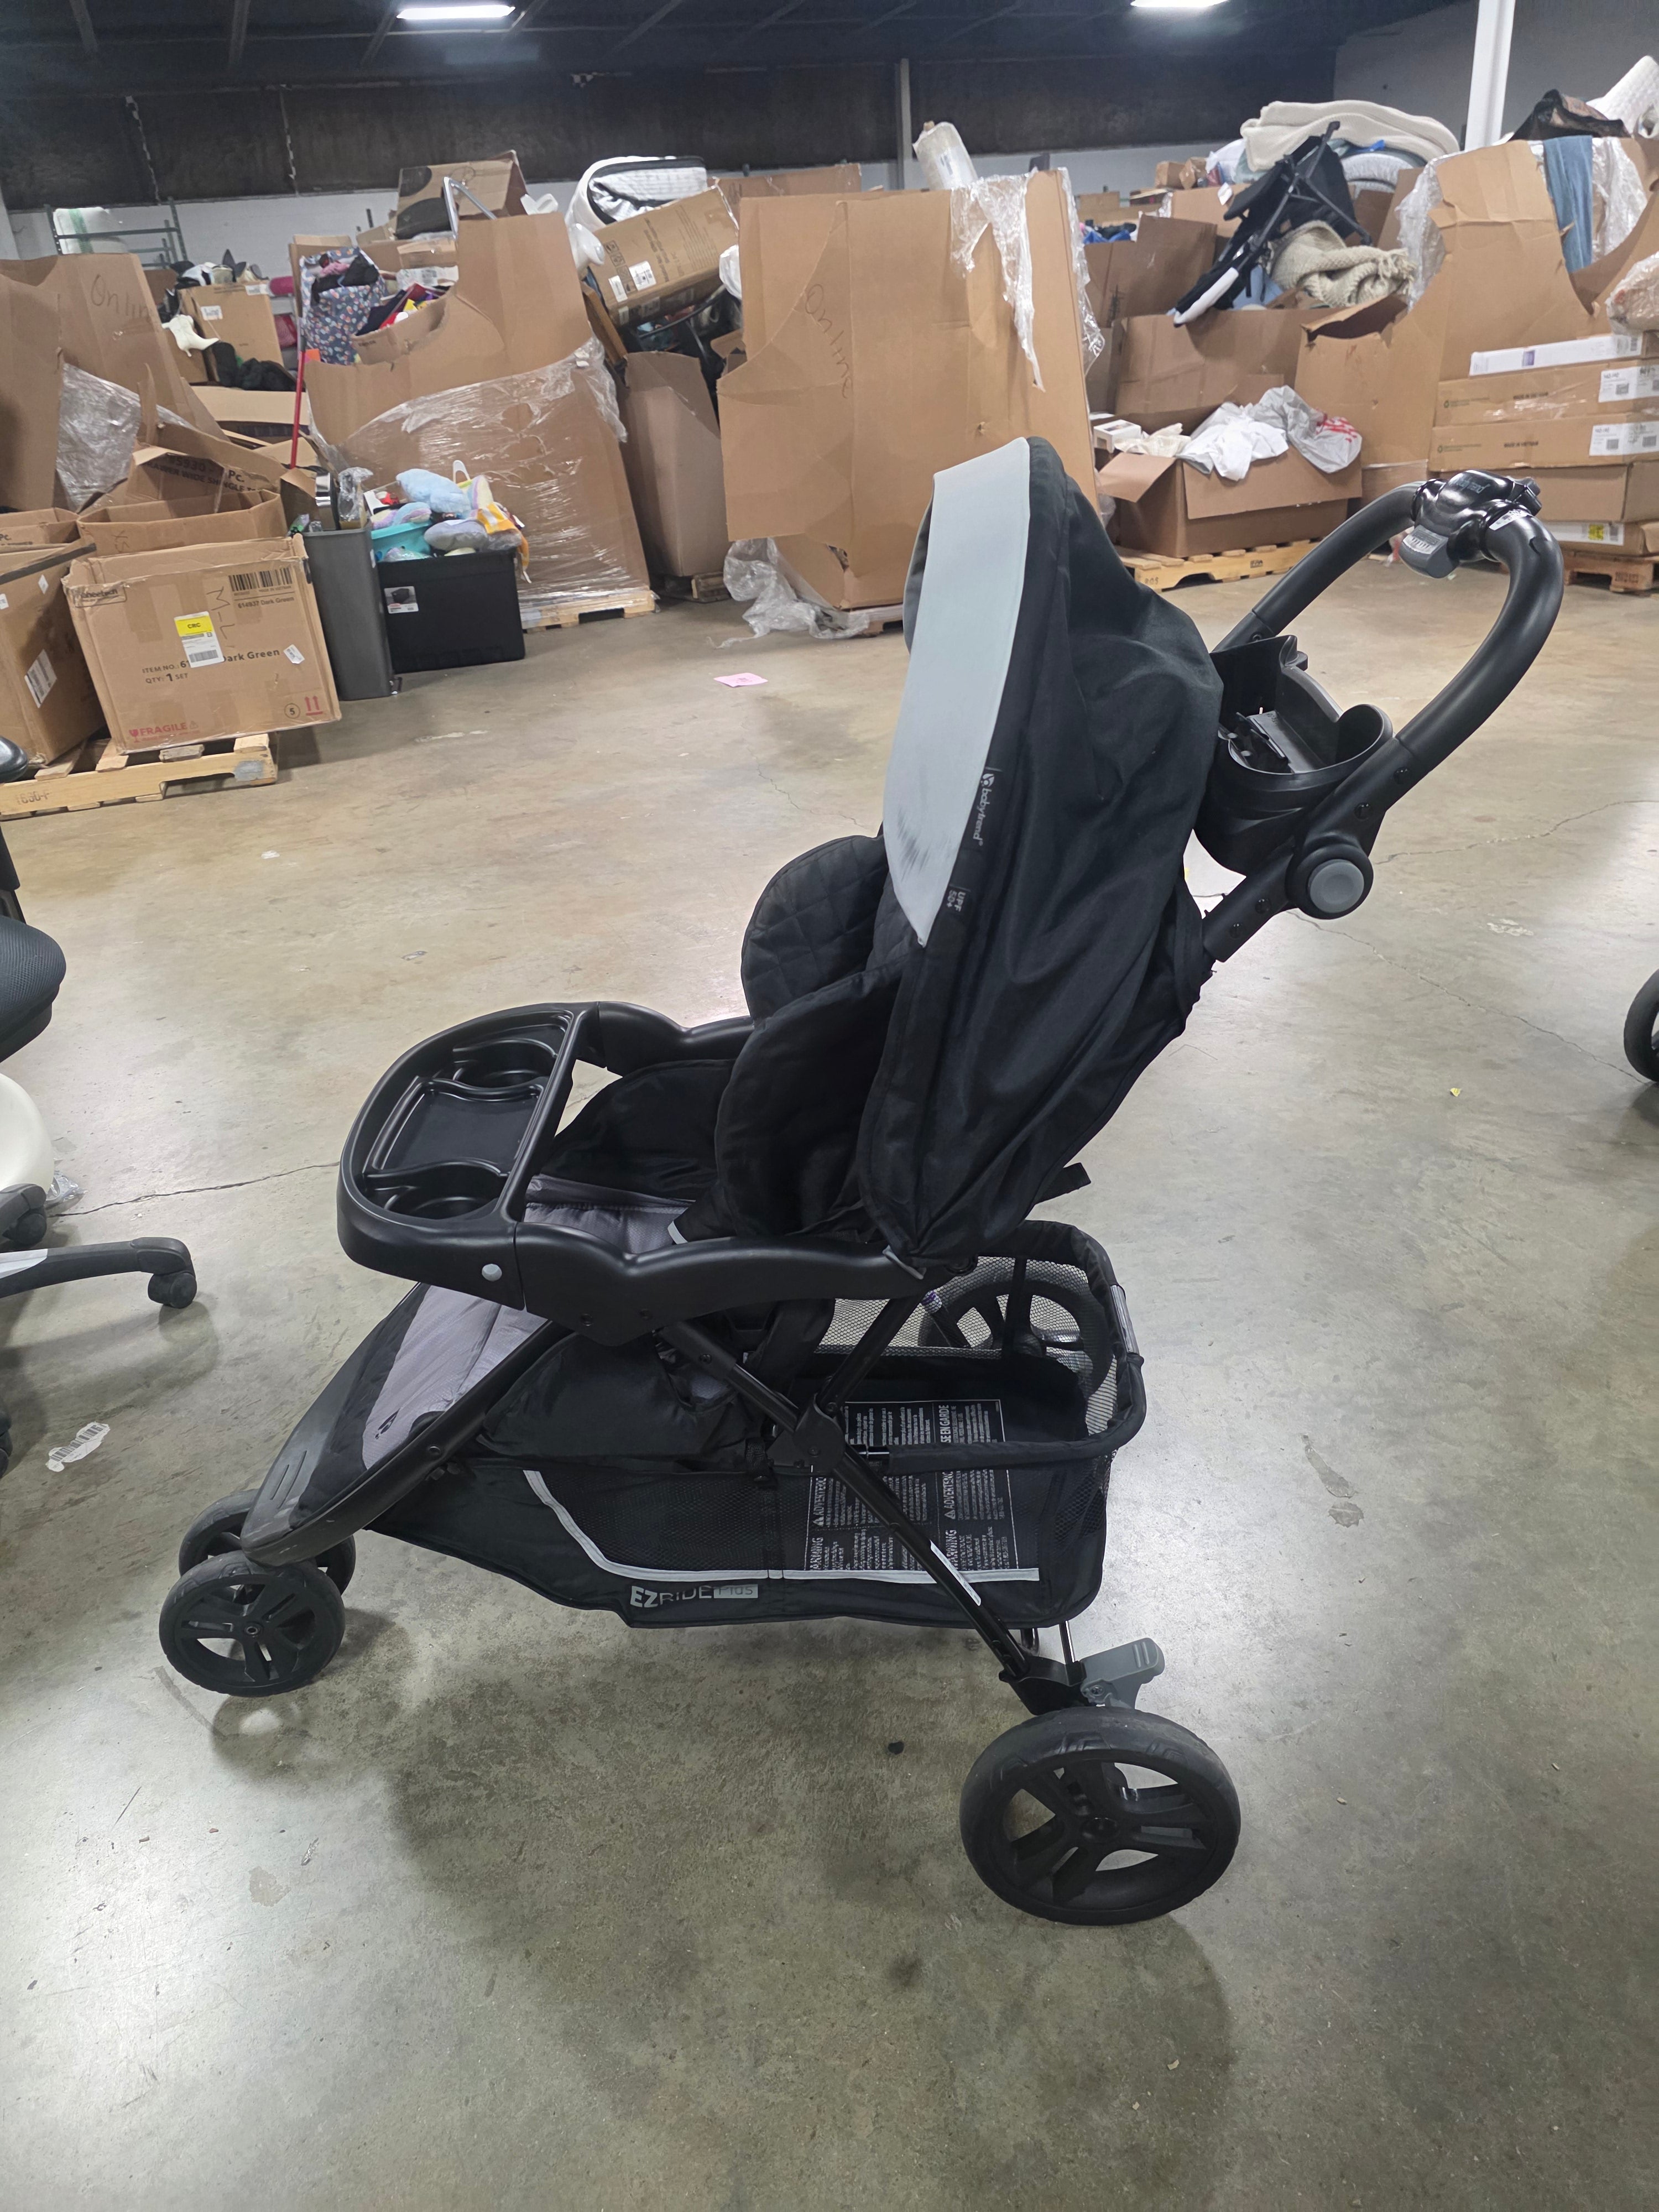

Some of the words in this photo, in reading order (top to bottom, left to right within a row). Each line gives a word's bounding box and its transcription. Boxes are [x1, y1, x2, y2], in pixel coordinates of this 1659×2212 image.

[142, 665, 161, 674] ITEM
[247, 649, 280, 659] Green
[166, 673, 173, 682] 1
[289, 707, 295, 716] 5
[140, 722, 188, 736] FRAGILE
[946, 889, 957, 909] 50+
[953, 891, 967, 913] UPF
[938, 1405, 950, 1426] GARDE
